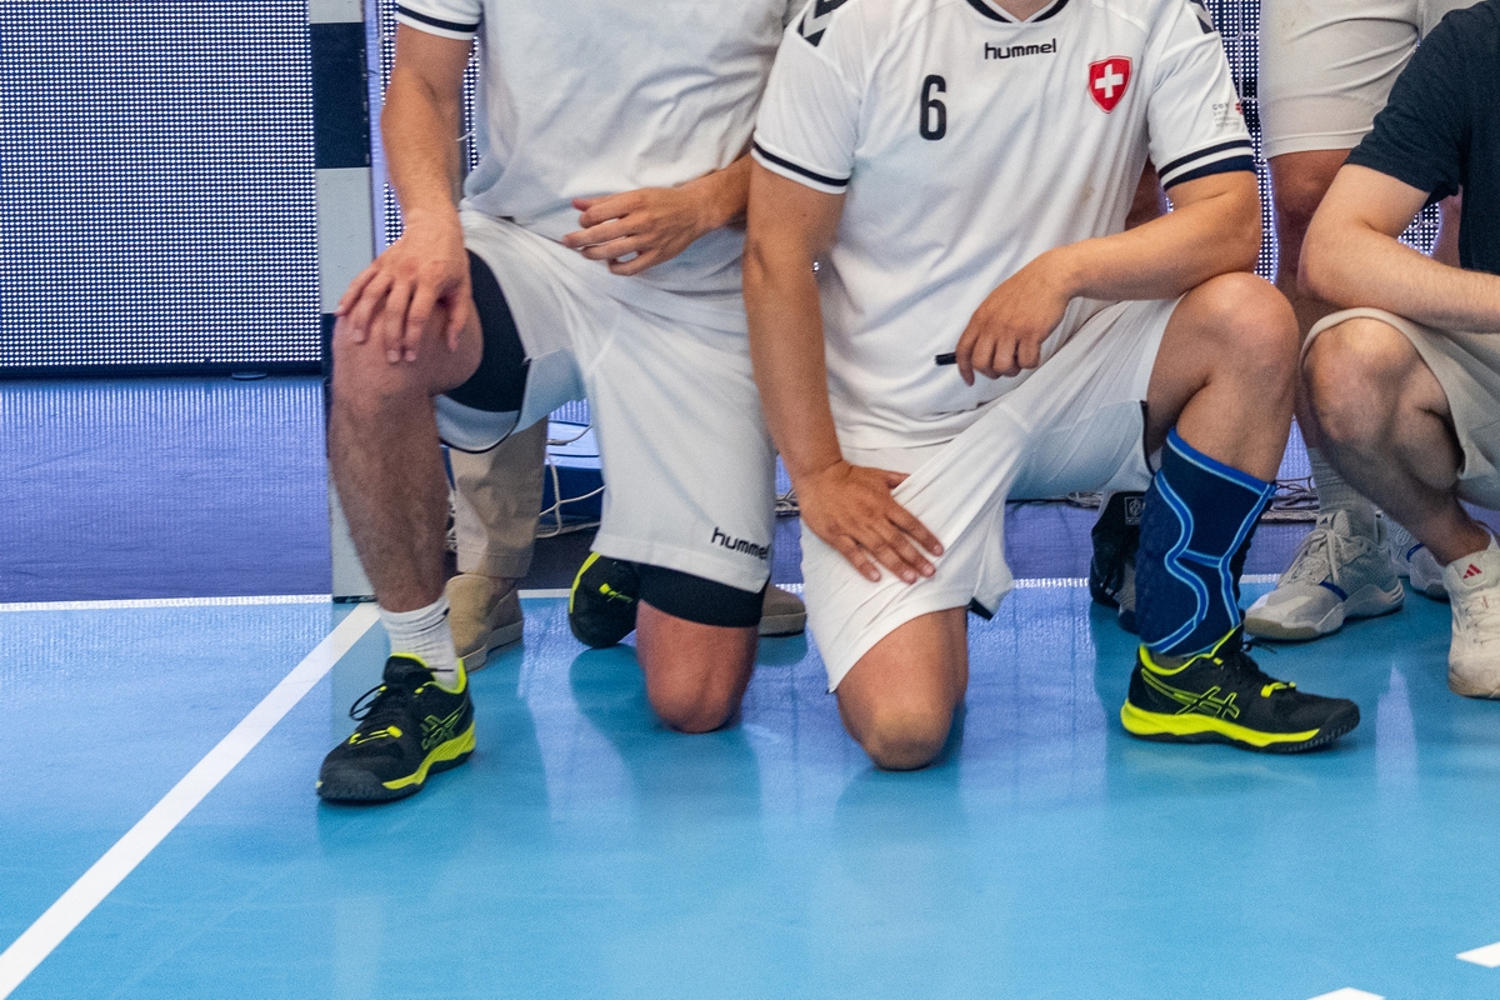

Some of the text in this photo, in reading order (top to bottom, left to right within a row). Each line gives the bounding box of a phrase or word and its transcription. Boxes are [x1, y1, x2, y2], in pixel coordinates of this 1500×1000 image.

[985, 38, 1057, 60] hummel
[919, 74, 947, 141] 6
[711, 526, 772, 561] hummel
